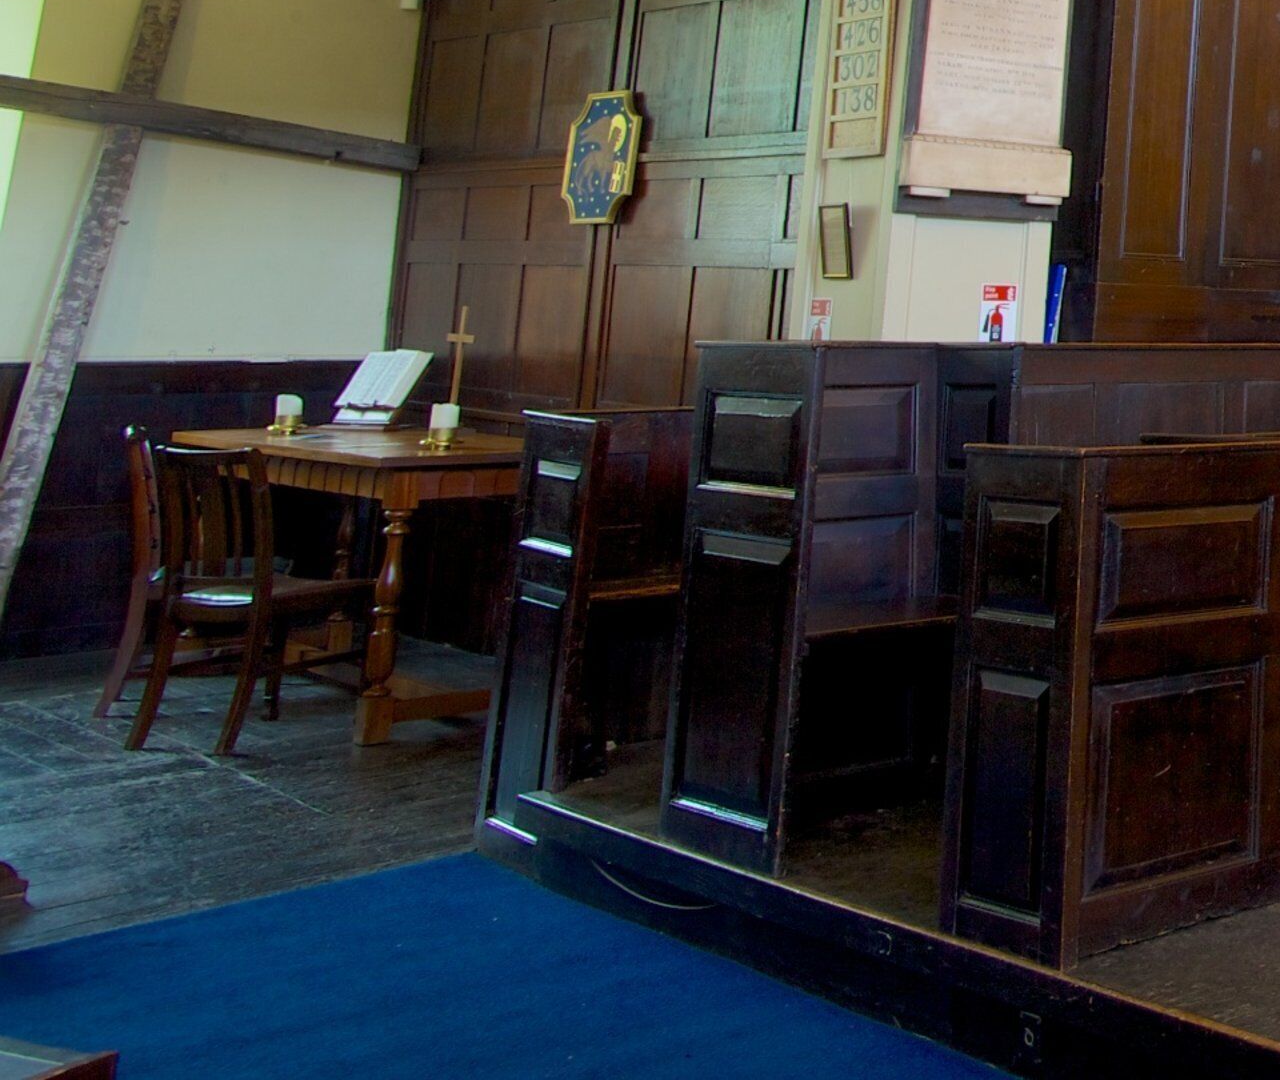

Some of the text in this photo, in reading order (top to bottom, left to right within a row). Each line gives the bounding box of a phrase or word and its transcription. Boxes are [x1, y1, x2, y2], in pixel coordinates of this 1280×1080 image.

[844, 19, 879, 48] 426
[840, 53, 876, 82] 302
[840, 87, 875, 115] 138
